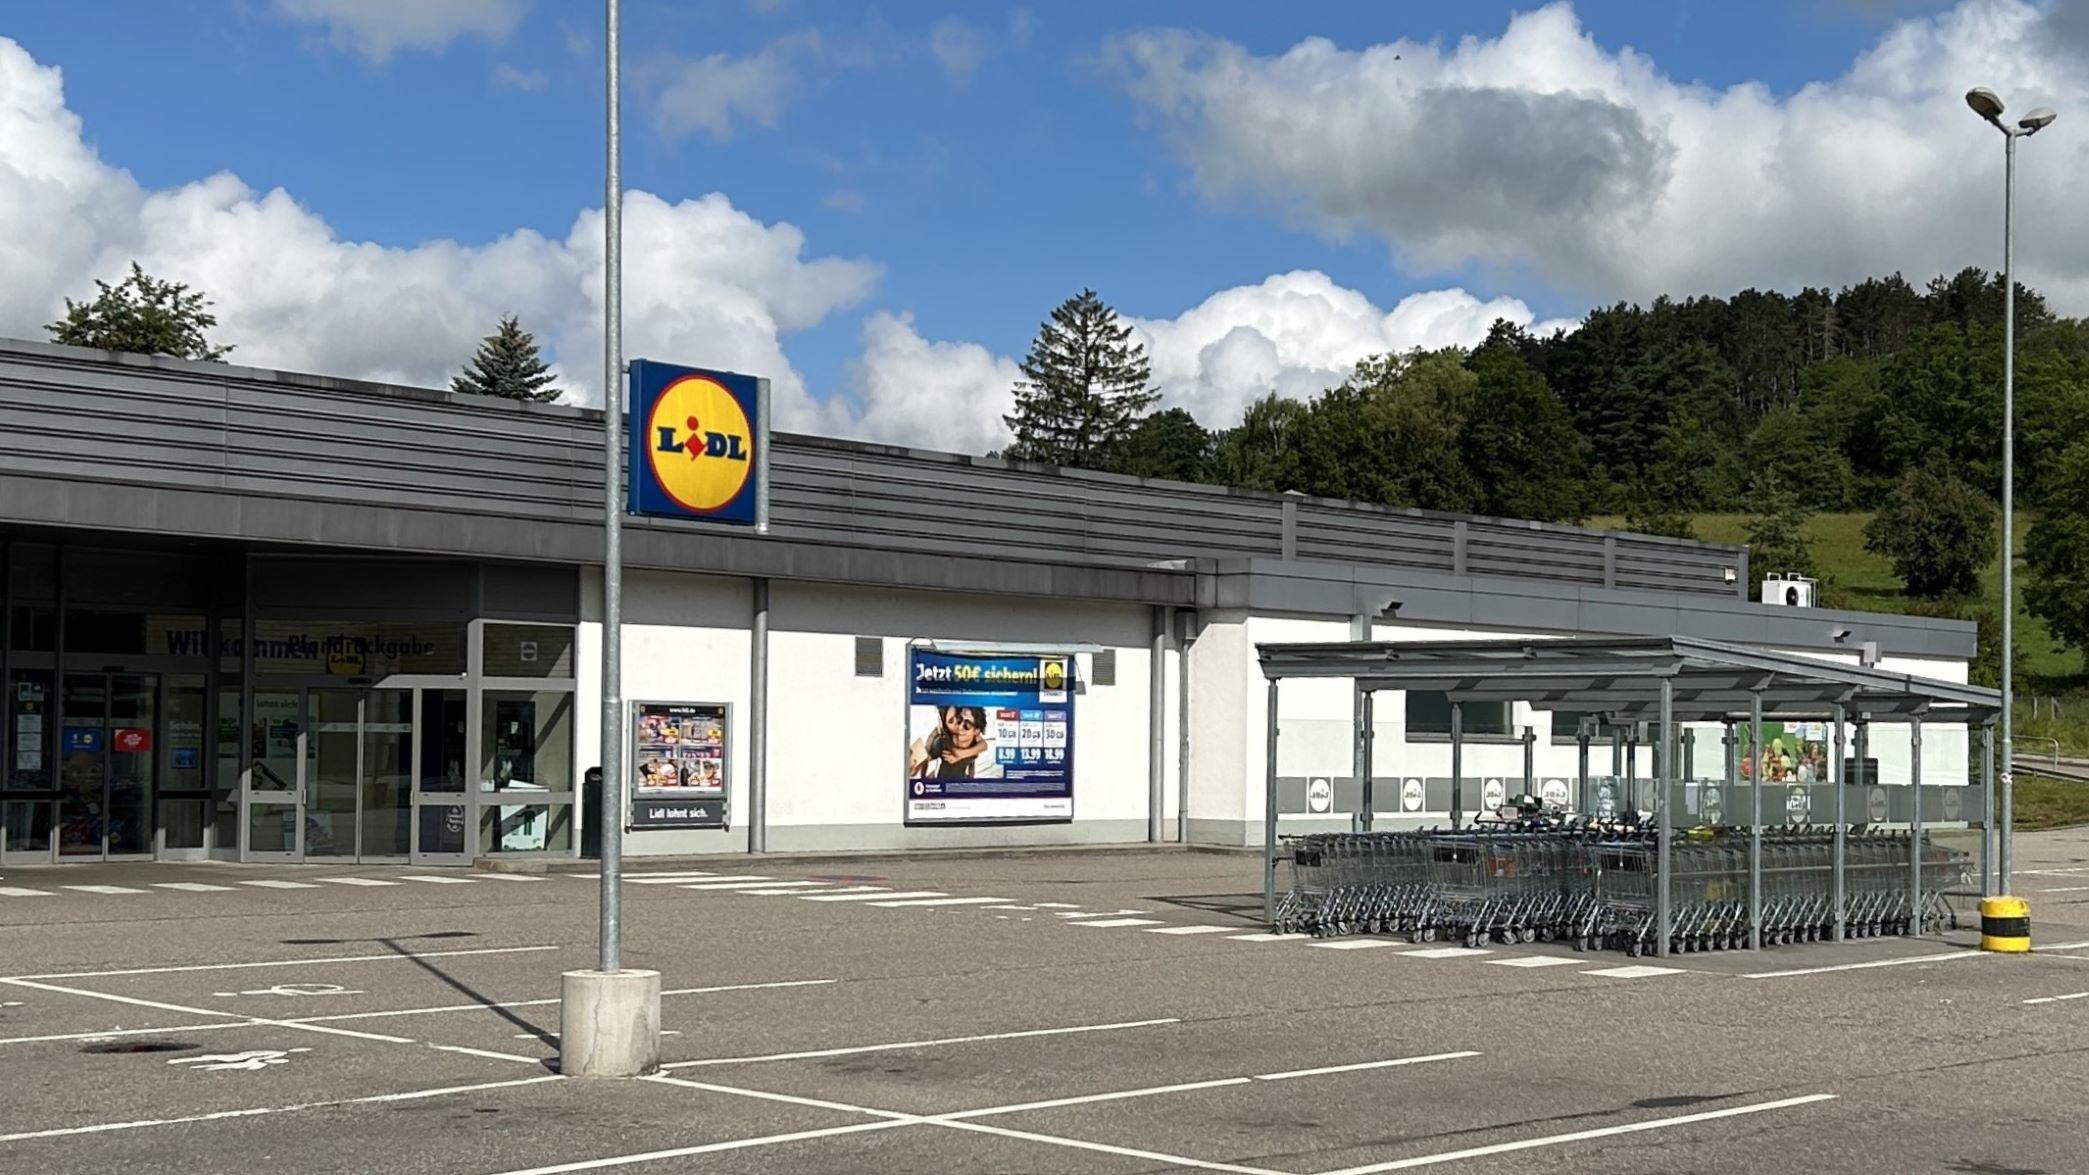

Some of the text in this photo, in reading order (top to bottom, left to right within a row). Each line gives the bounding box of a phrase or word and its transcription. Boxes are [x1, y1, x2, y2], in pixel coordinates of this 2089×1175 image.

[657, 416, 747, 461] LIDL
[916, 663, 1037, 684] Jetzt 50€ sichern!
[648, 807, 665, 819] Lidl
[666, 807, 688, 819] lohnt
